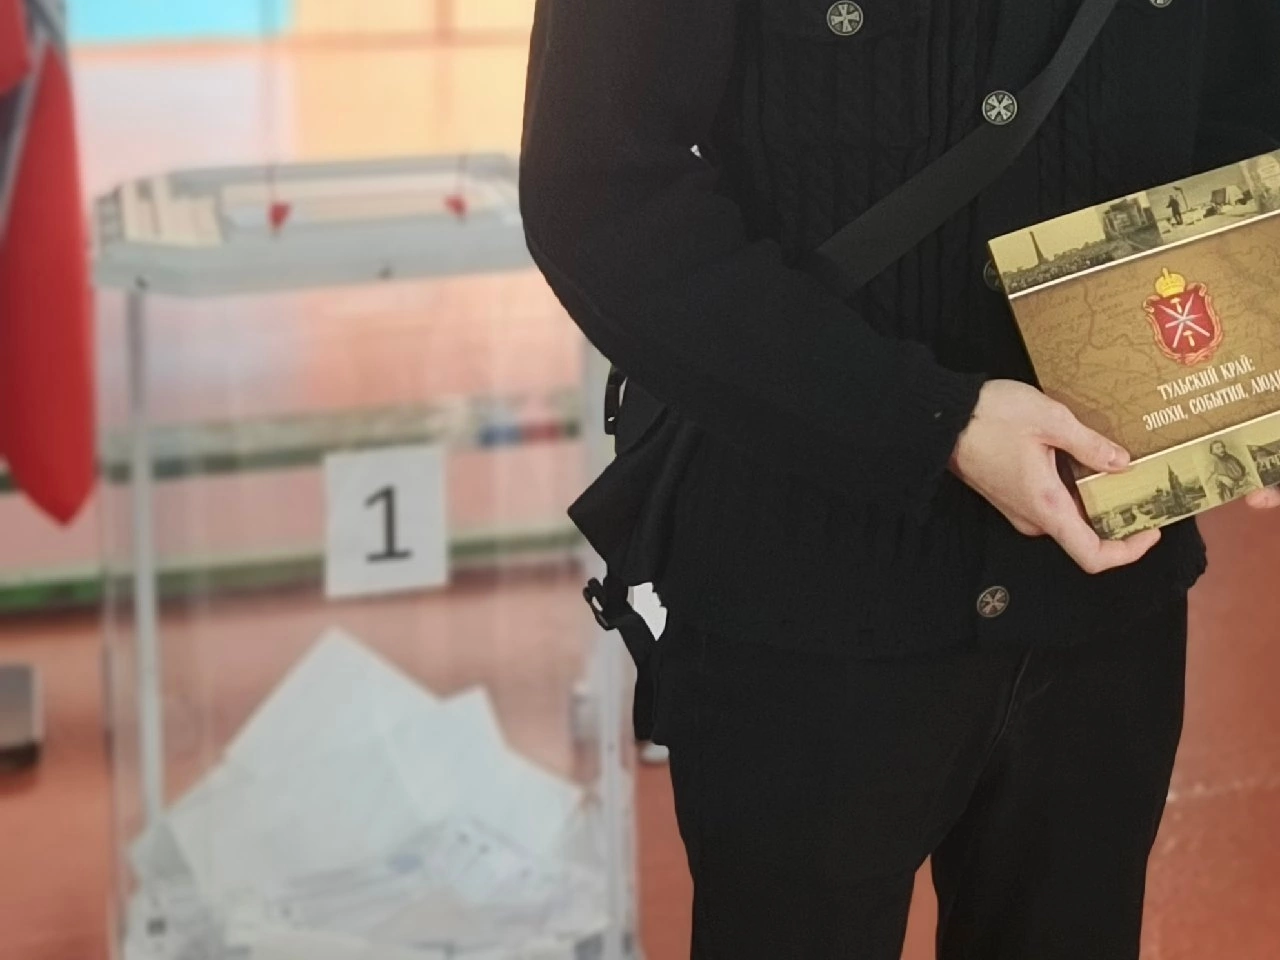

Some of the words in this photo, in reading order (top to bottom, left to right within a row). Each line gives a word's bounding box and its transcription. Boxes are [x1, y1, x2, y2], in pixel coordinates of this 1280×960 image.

[1157, 367, 1220, 401] ТУЛЬСКИЙ
[1220, 354, 1256, 380] КРАЙ:
[1142, 403, 1189, 431] ЭПОХИ,
[1189, 381, 1250, 415] СОБЫТИЯ,
[364, 484, 414, 562] 1
